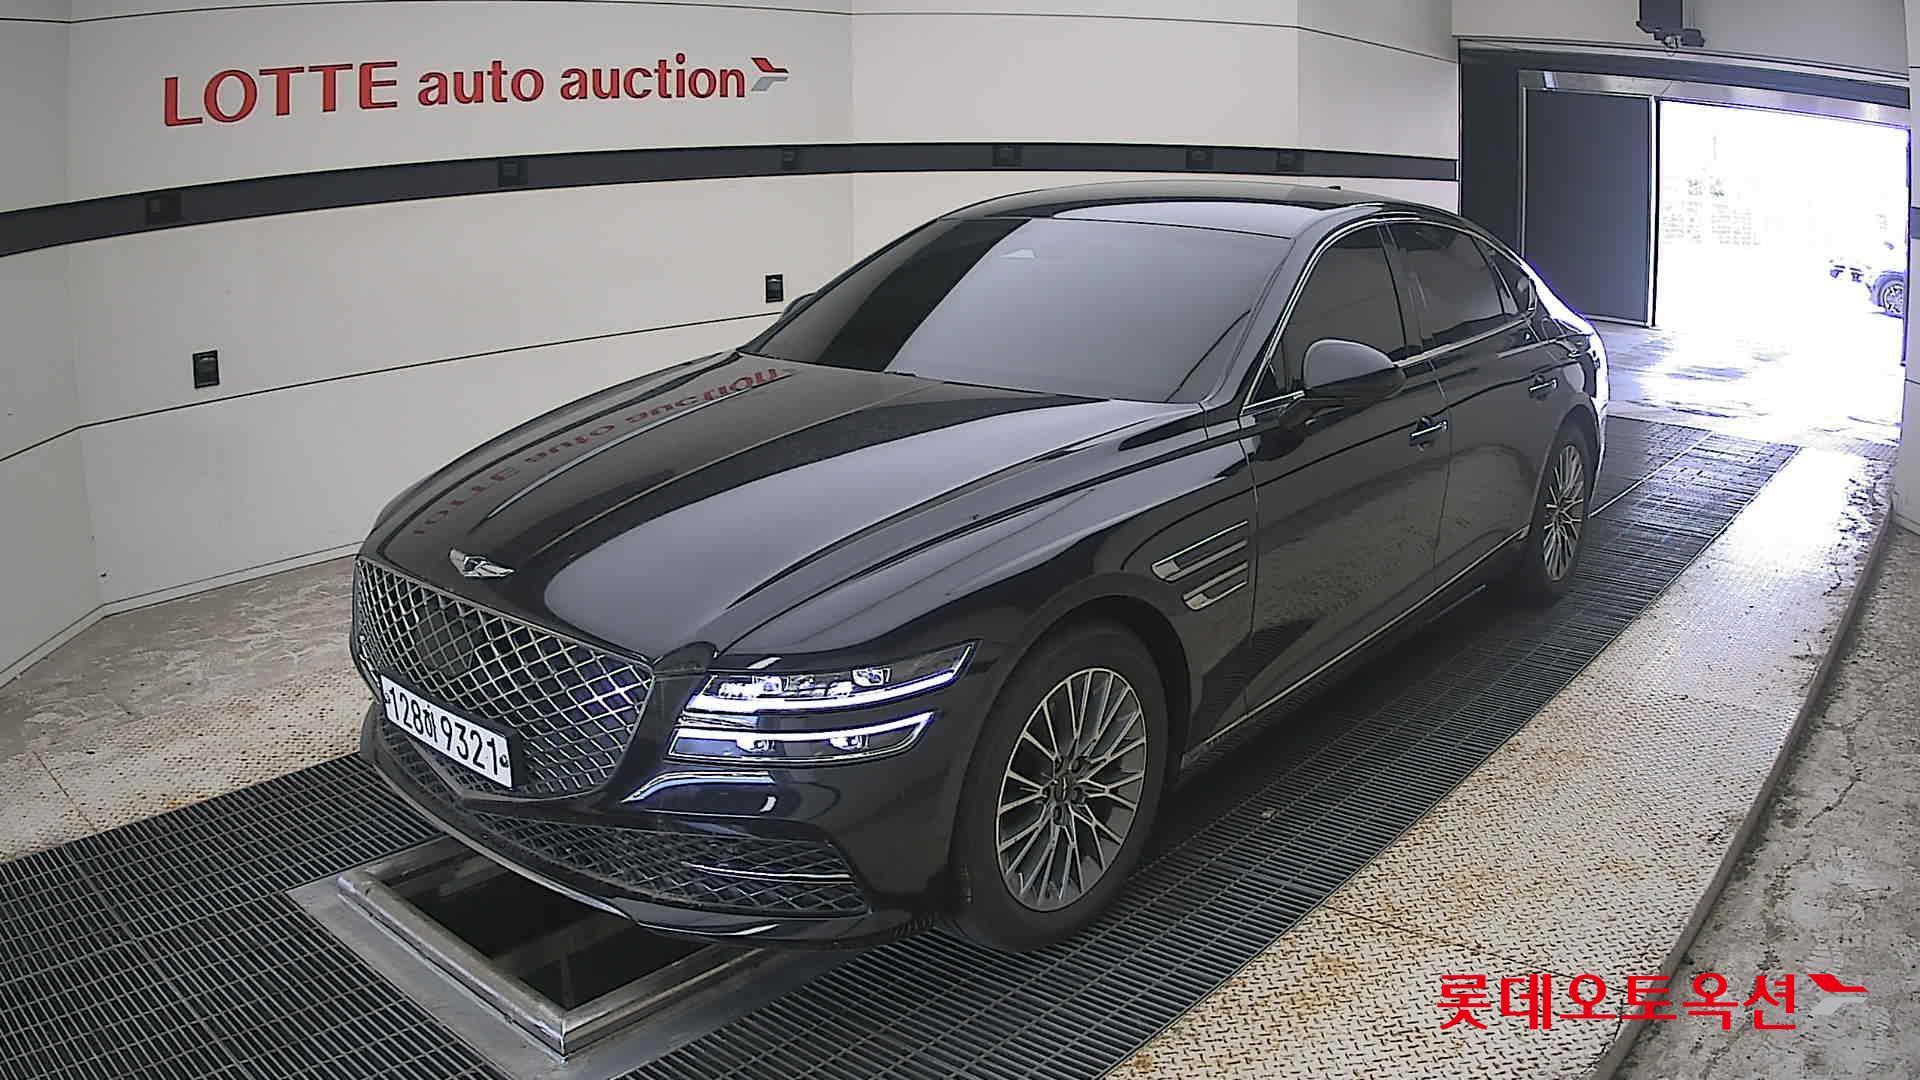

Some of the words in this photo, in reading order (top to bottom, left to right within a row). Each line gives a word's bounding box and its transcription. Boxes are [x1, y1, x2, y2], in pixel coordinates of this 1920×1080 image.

[164, 61, 398, 127] LOTTE
[417, 59, 544, 107] auto
[560, 53, 746, 100] auction
